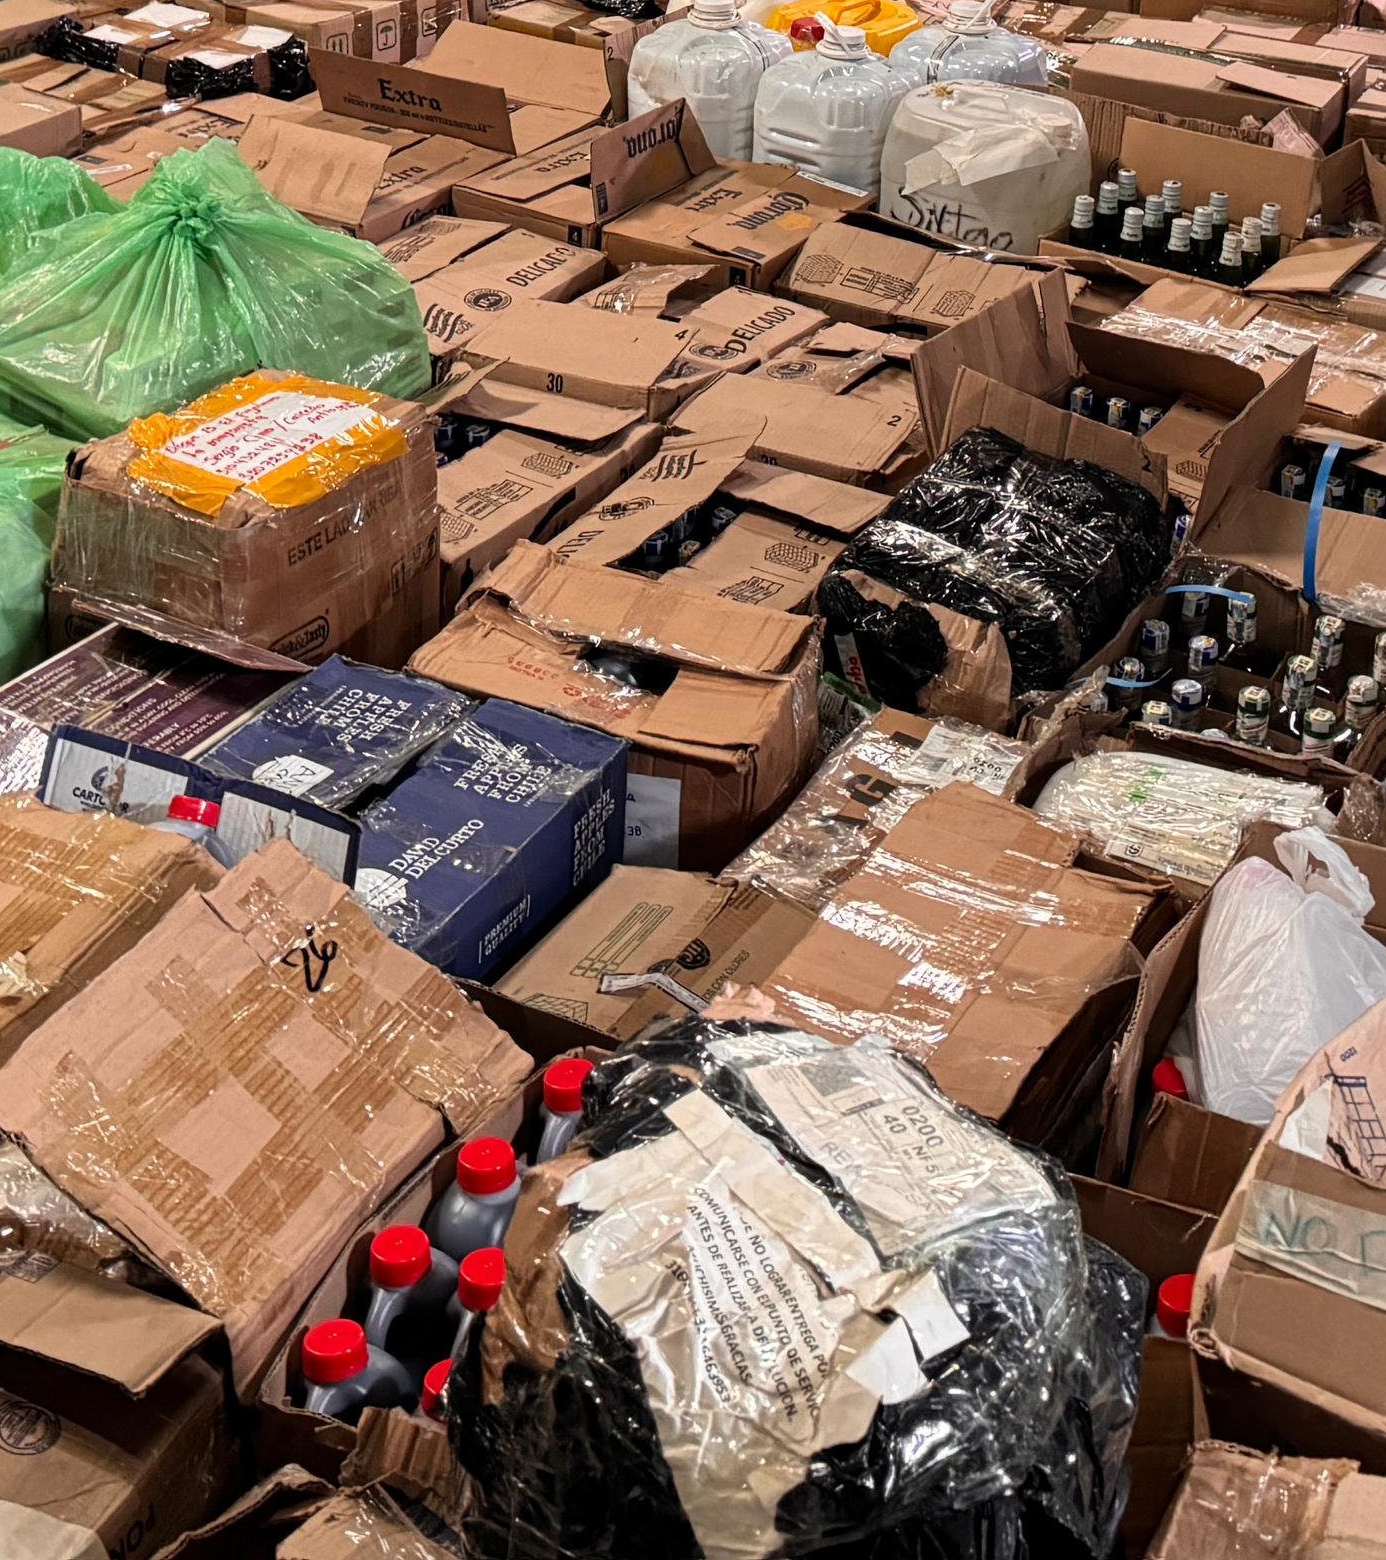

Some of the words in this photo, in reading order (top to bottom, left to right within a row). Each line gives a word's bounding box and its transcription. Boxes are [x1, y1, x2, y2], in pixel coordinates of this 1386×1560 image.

[377, 78, 443, 112] Extra
[506, 246, 577, 287] DELICADO
[674, 328, 688, 341] 4
[724, 305, 796, 354] DELICADO
[546, 372, 564, 393] 30
[888, 414, 902, 428] 2
[288, 533, 323, 567] ESTE
[325, 518, 356, 544] LAD
[317, 688, 363, 726] CHILE
[336, 695, 393, 744] APPLES
[338, 690, 381, 727] FROM
[362, 698, 412, 741] FRESH
[140, 721, 181, 751] FERABLY
[487, 759, 535, 801] FROM
[506, 765, 553, 804] CHILE
[573, 788, 611, 838] FRESH
[574, 799, 615, 854] APPLES
[388, 836, 440, 872] DAVID
[573, 827, 605, 871] FROM
[573, 840, 606, 886] CHILE
[484, 900, 528, 947] PREMIUM
[484, 914, 526, 956] QUALITY
[882, 1113, 907, 1134] 40
[686, 1204, 716, 1245] ANTES
[707, 1244, 725, 1262] DE
[1261, 1211, 1338, 1253] NO
[694, 1187, 749, 1267] COMUNICARSE
[743, 1267, 763, 1293] CON
[765, 1302, 792, 1347] PUNTO
[786, 1347, 801, 1368] DE
[749, 1235, 766, 1256] NO
[762, 1256, 792, 1302] LOGRAR
[784, 1293, 821, 1353] ENTREGA
